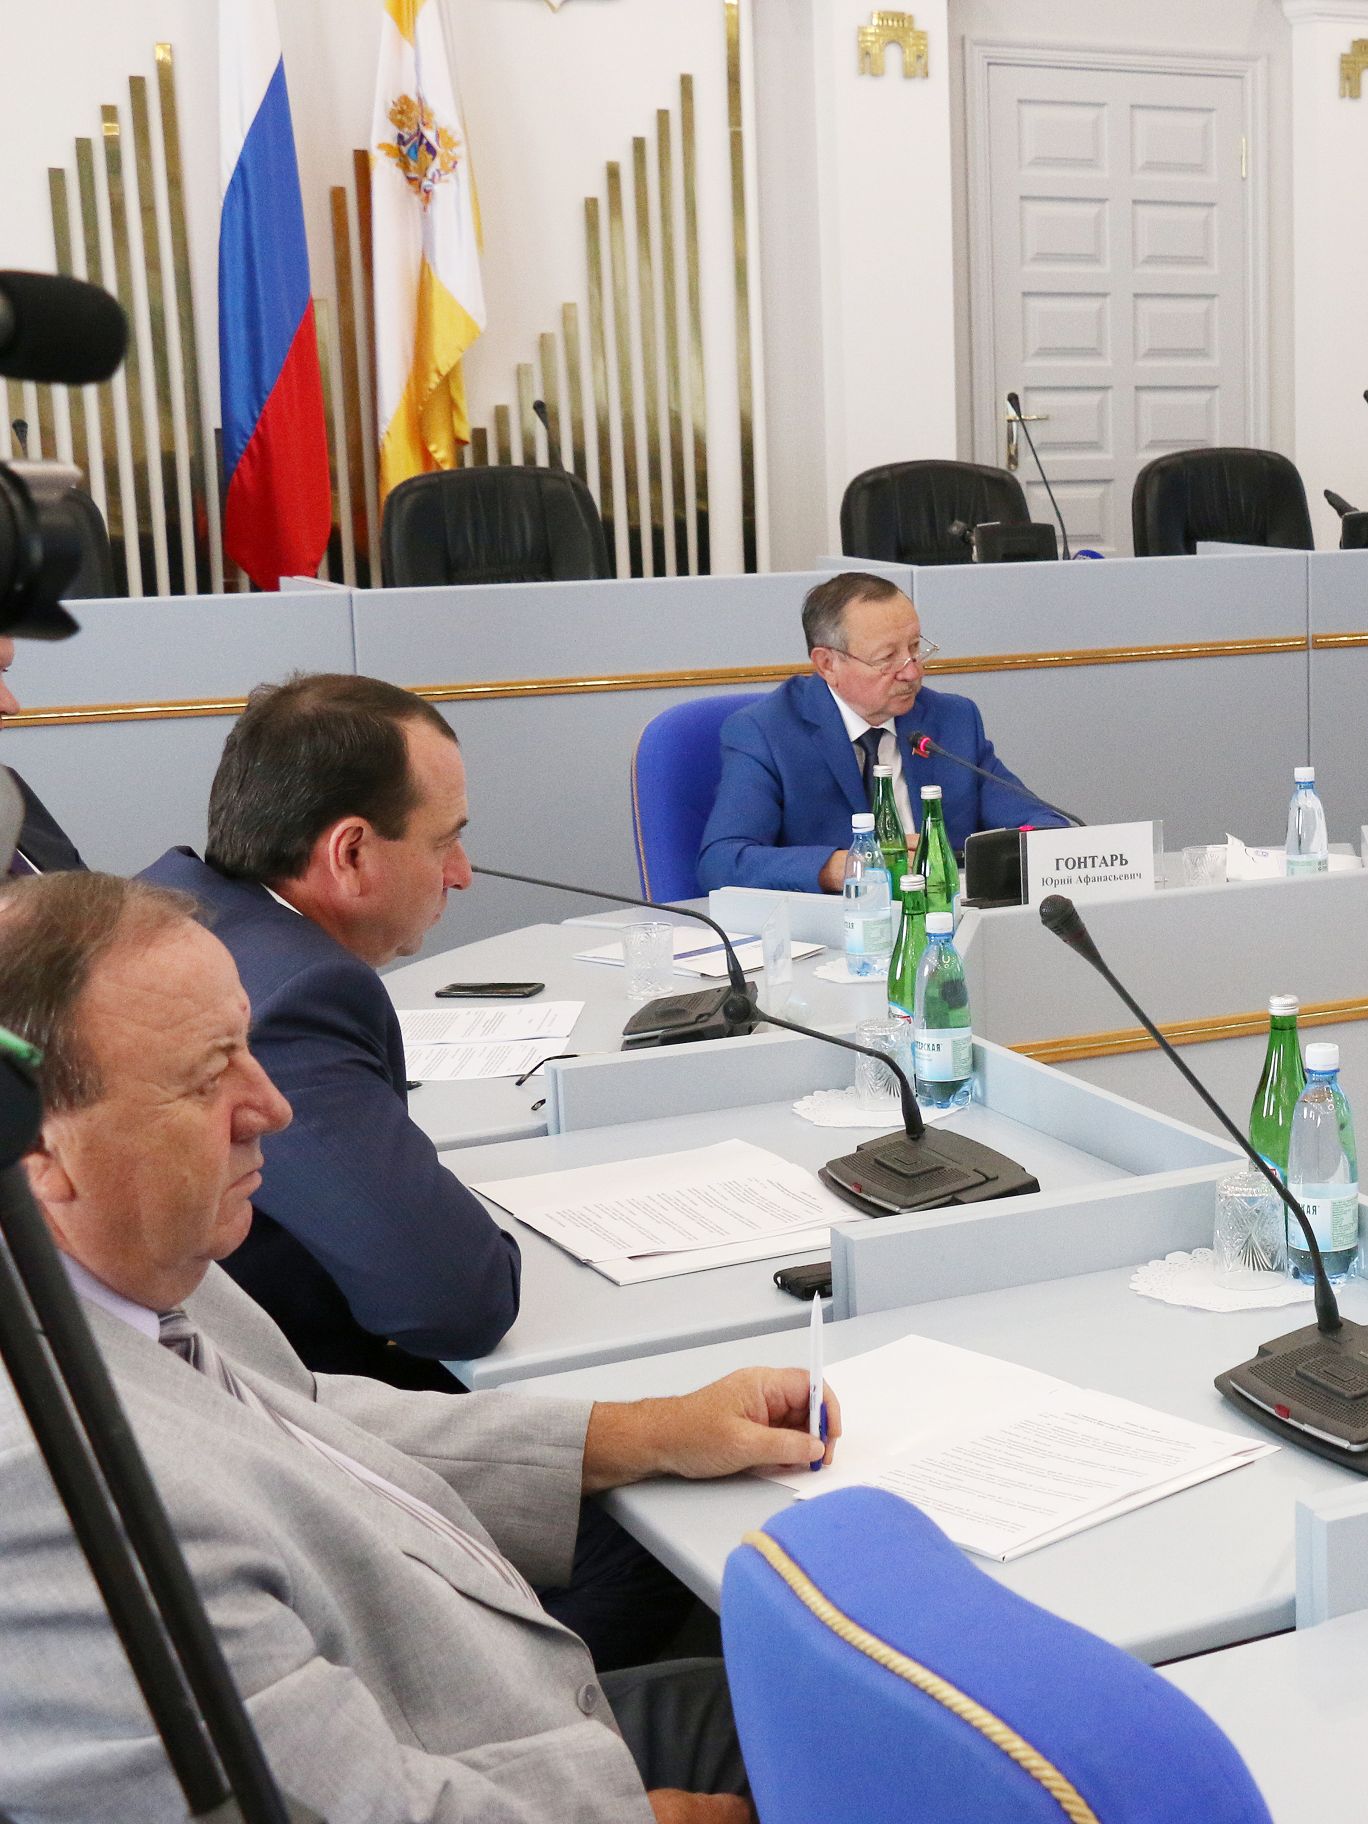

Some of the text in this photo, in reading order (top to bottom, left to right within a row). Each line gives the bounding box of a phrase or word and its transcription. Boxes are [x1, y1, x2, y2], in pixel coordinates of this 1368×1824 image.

[1055, 853, 1129, 871] ГОНТАРЬ
[1041, 871, 1142, 888] Юрий Афанасьевич
